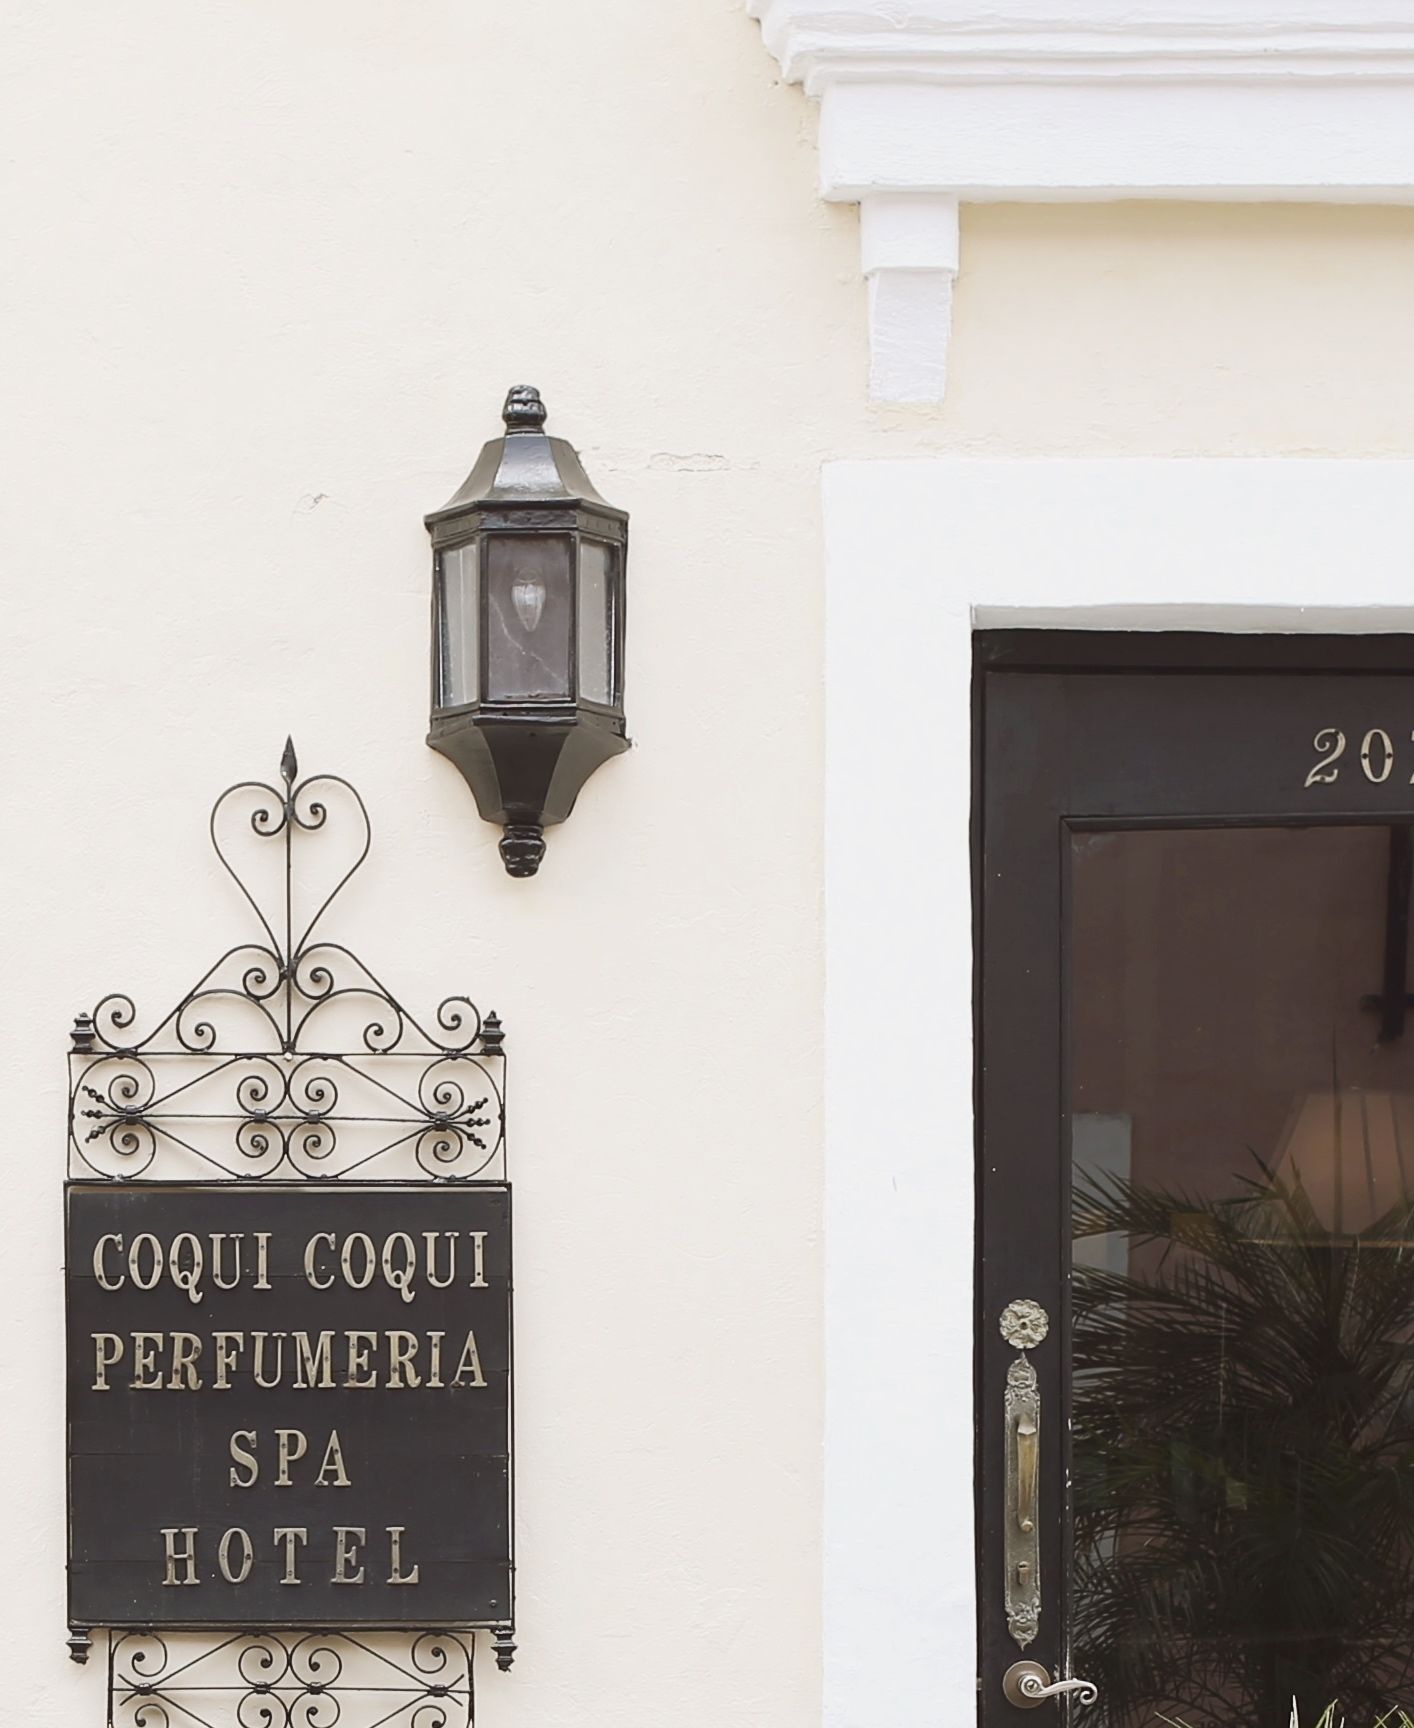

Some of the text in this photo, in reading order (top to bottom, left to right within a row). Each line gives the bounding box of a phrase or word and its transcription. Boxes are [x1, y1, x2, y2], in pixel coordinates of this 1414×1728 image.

[92, 1232, 489, 1303] COQUI COQUI
[91, 1330, 488, 1389] PERFUMERIA
[229, 1429, 352, 1487] SPA
[161, 1527, 420, 1586] HOTEL
